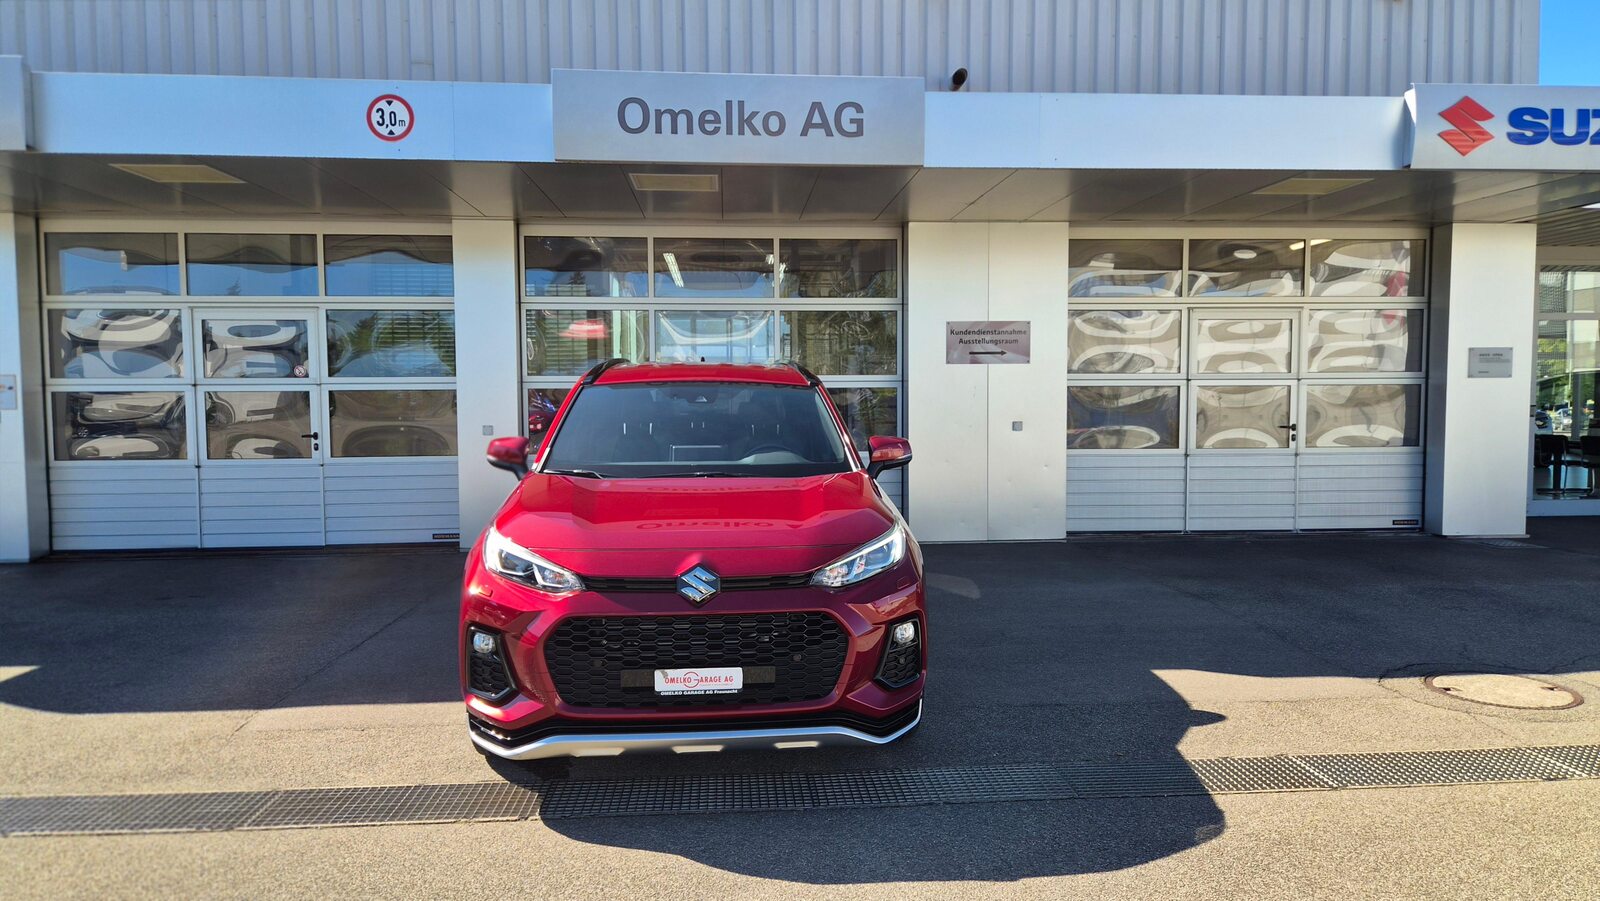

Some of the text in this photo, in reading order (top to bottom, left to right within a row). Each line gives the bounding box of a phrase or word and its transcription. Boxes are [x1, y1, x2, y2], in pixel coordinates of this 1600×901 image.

[376, 107, 397, 129] 3,0
[617, 97, 864, 138] Omelko AG
[1506, 107, 1600, 146] SU
[950, 328, 1027, 336] Kundendienstannahme
[958, 338, 1019, 346] Ausstellungsraum
